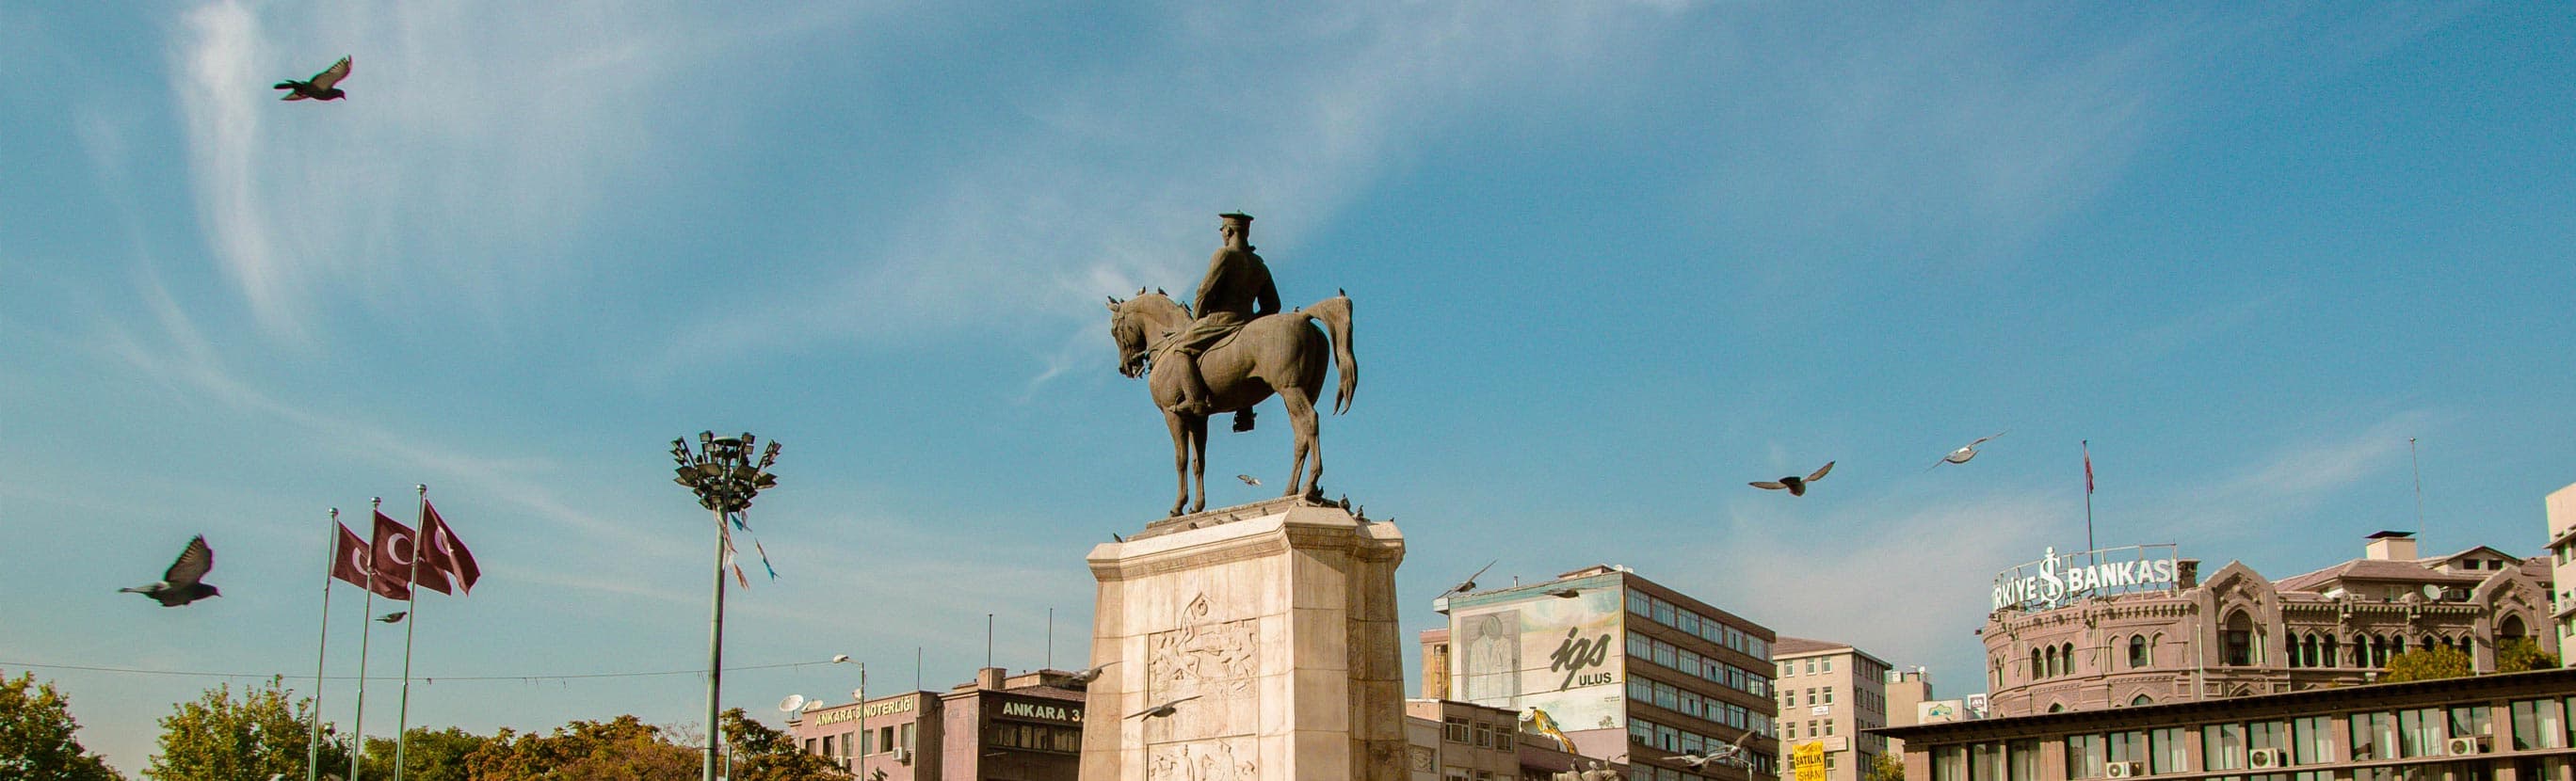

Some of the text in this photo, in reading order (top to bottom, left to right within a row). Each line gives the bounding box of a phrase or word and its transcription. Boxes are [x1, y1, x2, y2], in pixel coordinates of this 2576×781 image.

[2069, 560, 2179, 592] BANKASI
[1579, 672, 1612, 686] ULUS
[815, 709, 853, 726] ANKARA
[1003, 702, 1067, 721] ANKARA
[1795, 754, 1822, 766] SATILIK
